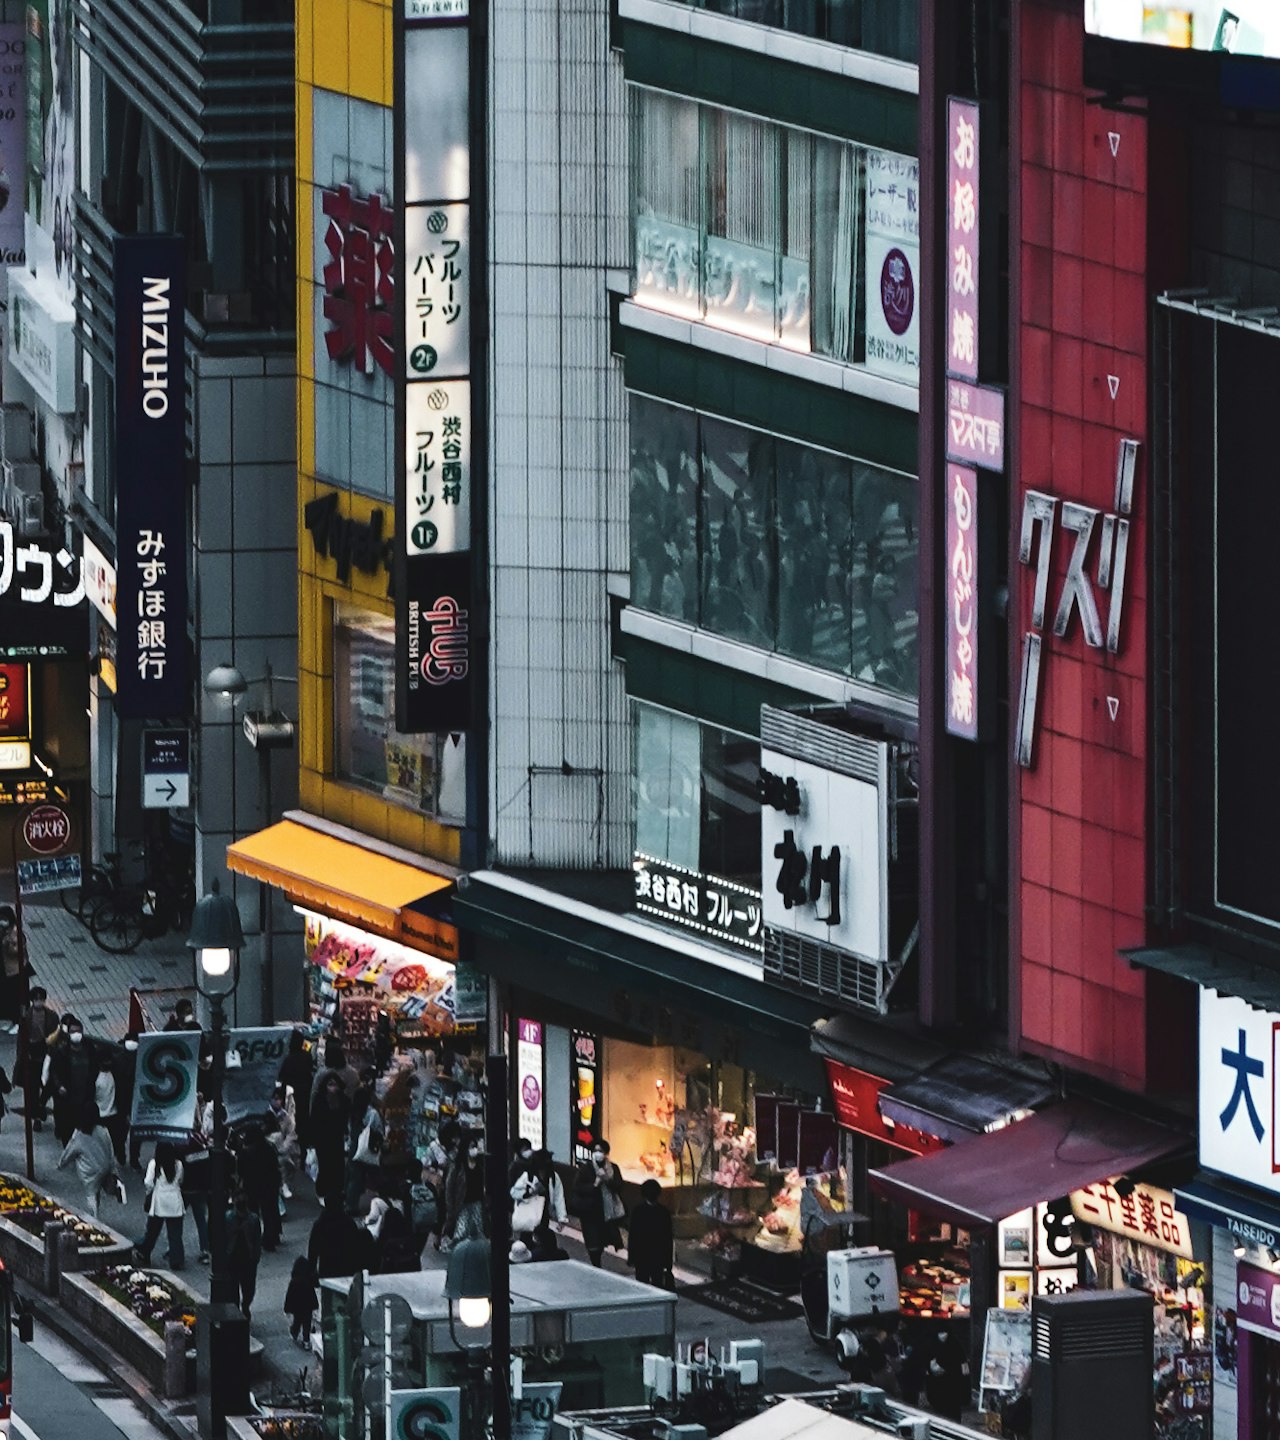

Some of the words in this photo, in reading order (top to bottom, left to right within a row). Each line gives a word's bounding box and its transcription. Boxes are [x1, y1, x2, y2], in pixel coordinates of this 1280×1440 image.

[413, 253, 435, 339] パーラー
[439, 239, 461, 327] フルーツ
[141, 276, 171, 421] MIZUHO
[414, 430, 436, 516] フルーツ
[440, 416, 462, 505] 渋谷西村
[136, 529, 167, 681] みずほ銀行
[408, 600, 420, 658] BRITISH
[421, 595, 469, 687] HUB
[408, 660, 420, 691] PUB
[28, 820, 66, 840] 消火栓
[635, 869, 699, 917] 渋谷西村
[706, 889, 762, 932] フルーツ
[522, 1021, 539, 1043] 4F
[1220, 1028, 1265, 1143] 大
[1227, 1217, 1275, 1247] TAISEIDO
